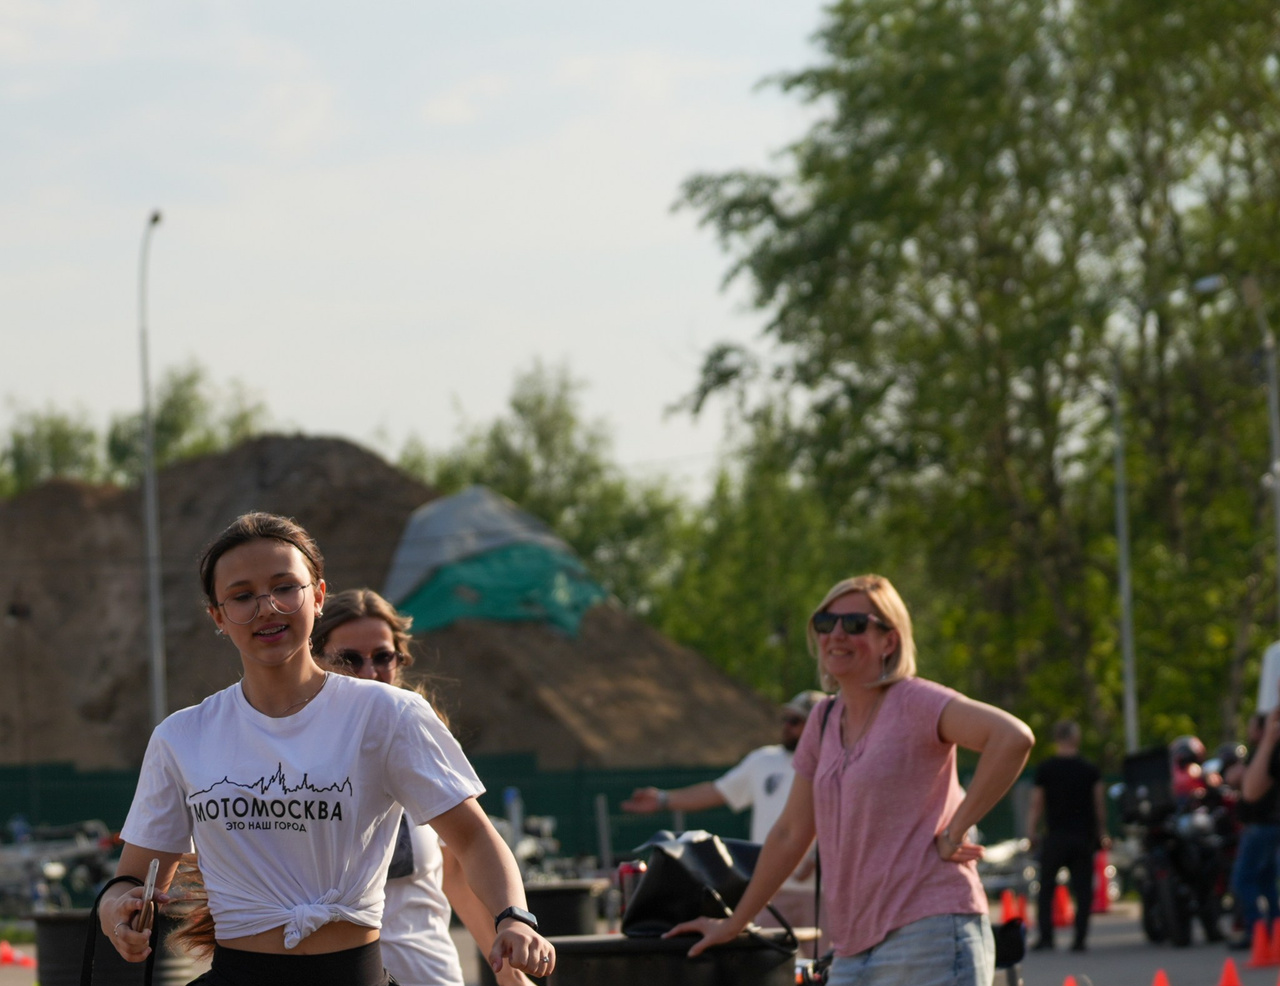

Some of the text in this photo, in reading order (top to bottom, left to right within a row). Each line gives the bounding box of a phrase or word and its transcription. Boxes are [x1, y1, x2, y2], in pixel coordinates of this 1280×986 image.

[193, 797, 343, 823] МОТОМОСКВА
[226, 821, 307, 832] ЭТО НАШ ГОРОД
